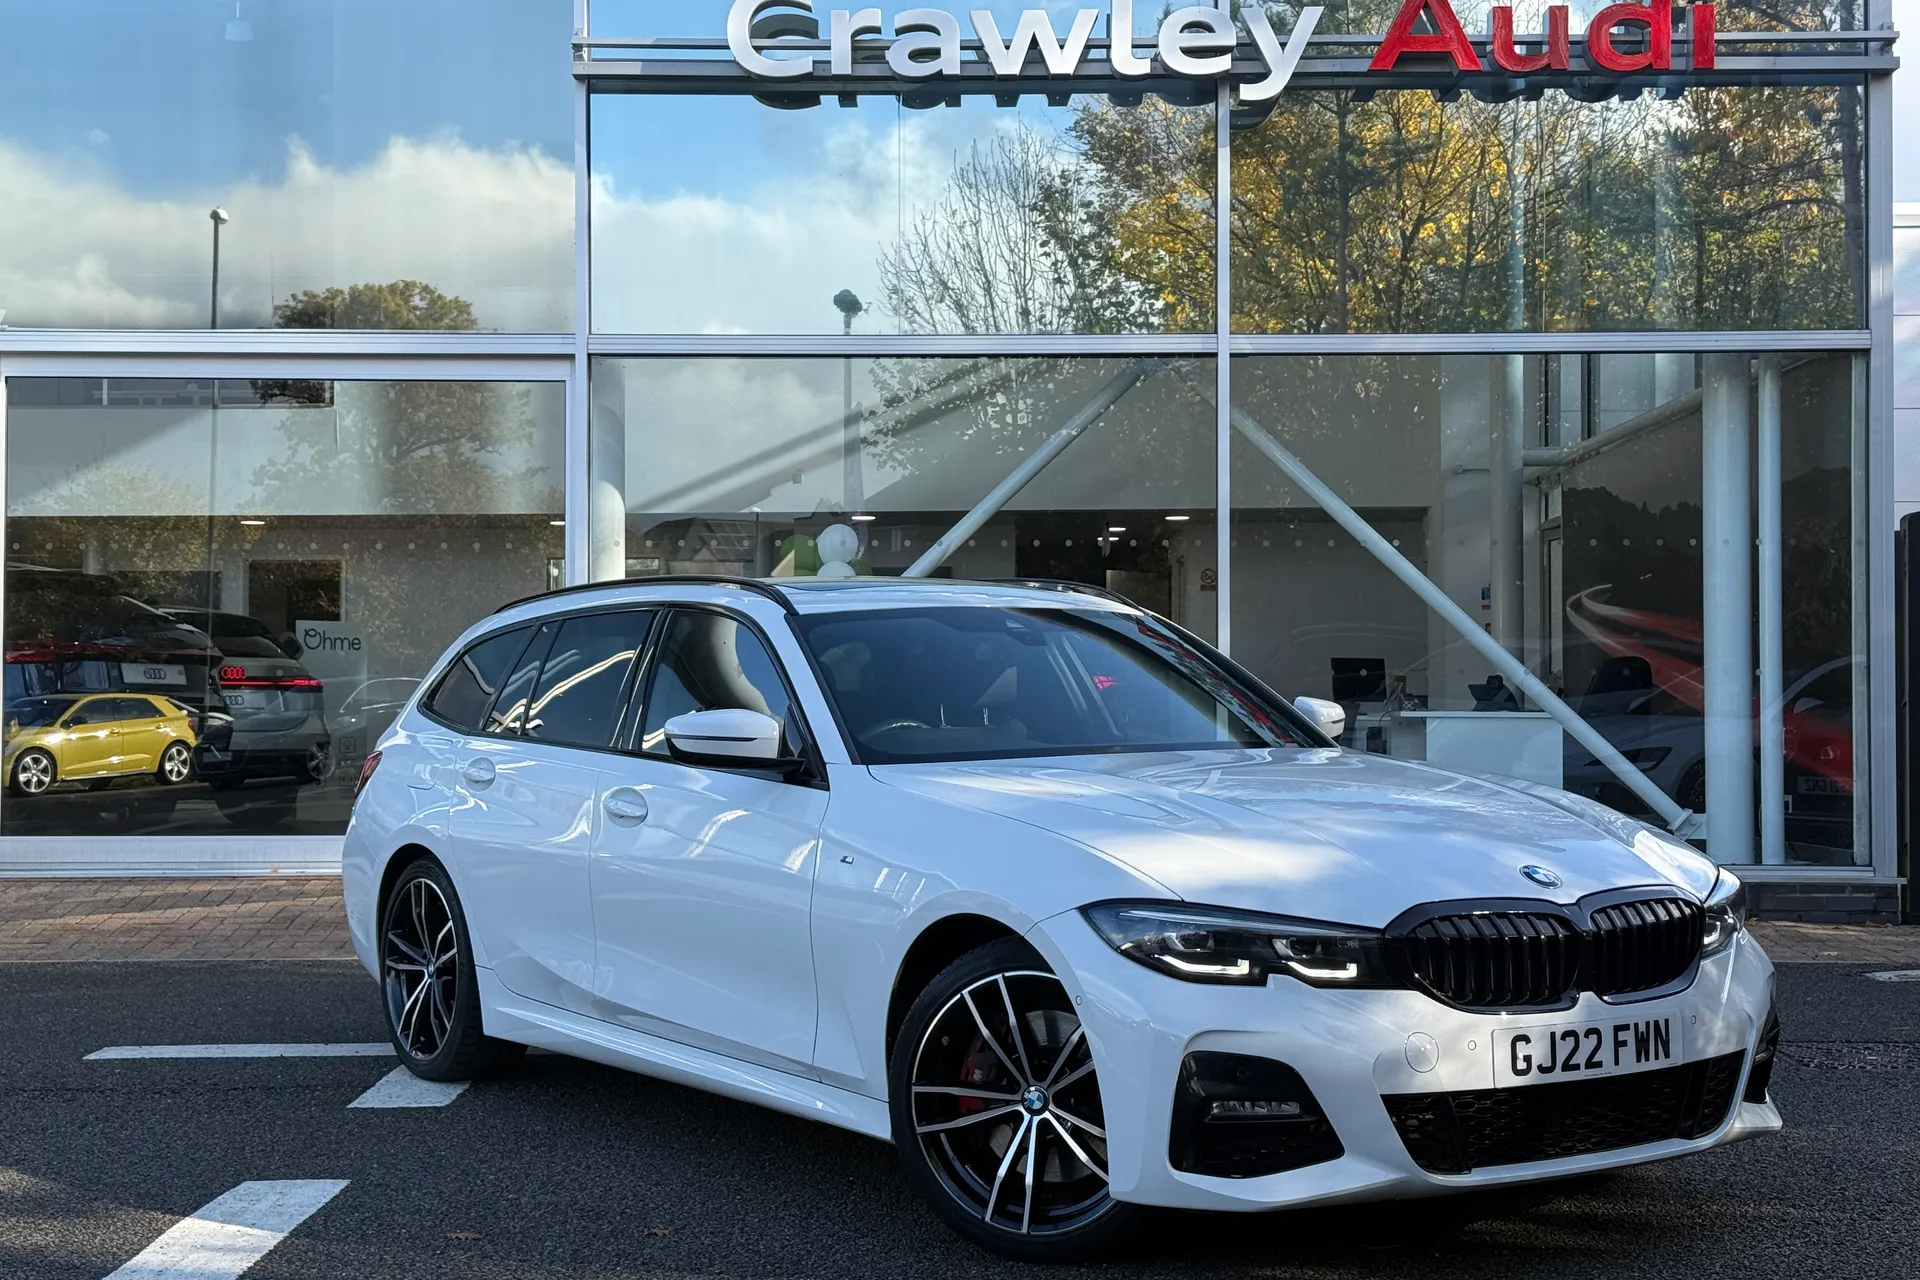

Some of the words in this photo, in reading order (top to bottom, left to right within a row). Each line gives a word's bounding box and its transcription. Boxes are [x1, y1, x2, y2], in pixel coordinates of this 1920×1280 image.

[726, 0, 1324, 101] Crawley
[1368, 0, 1716, 73] Audi
[304, 628, 362, 651] Ohme
[1510, 1027, 1603, 1077] GJ22
[1612, 1017, 1671, 1066] FWN
